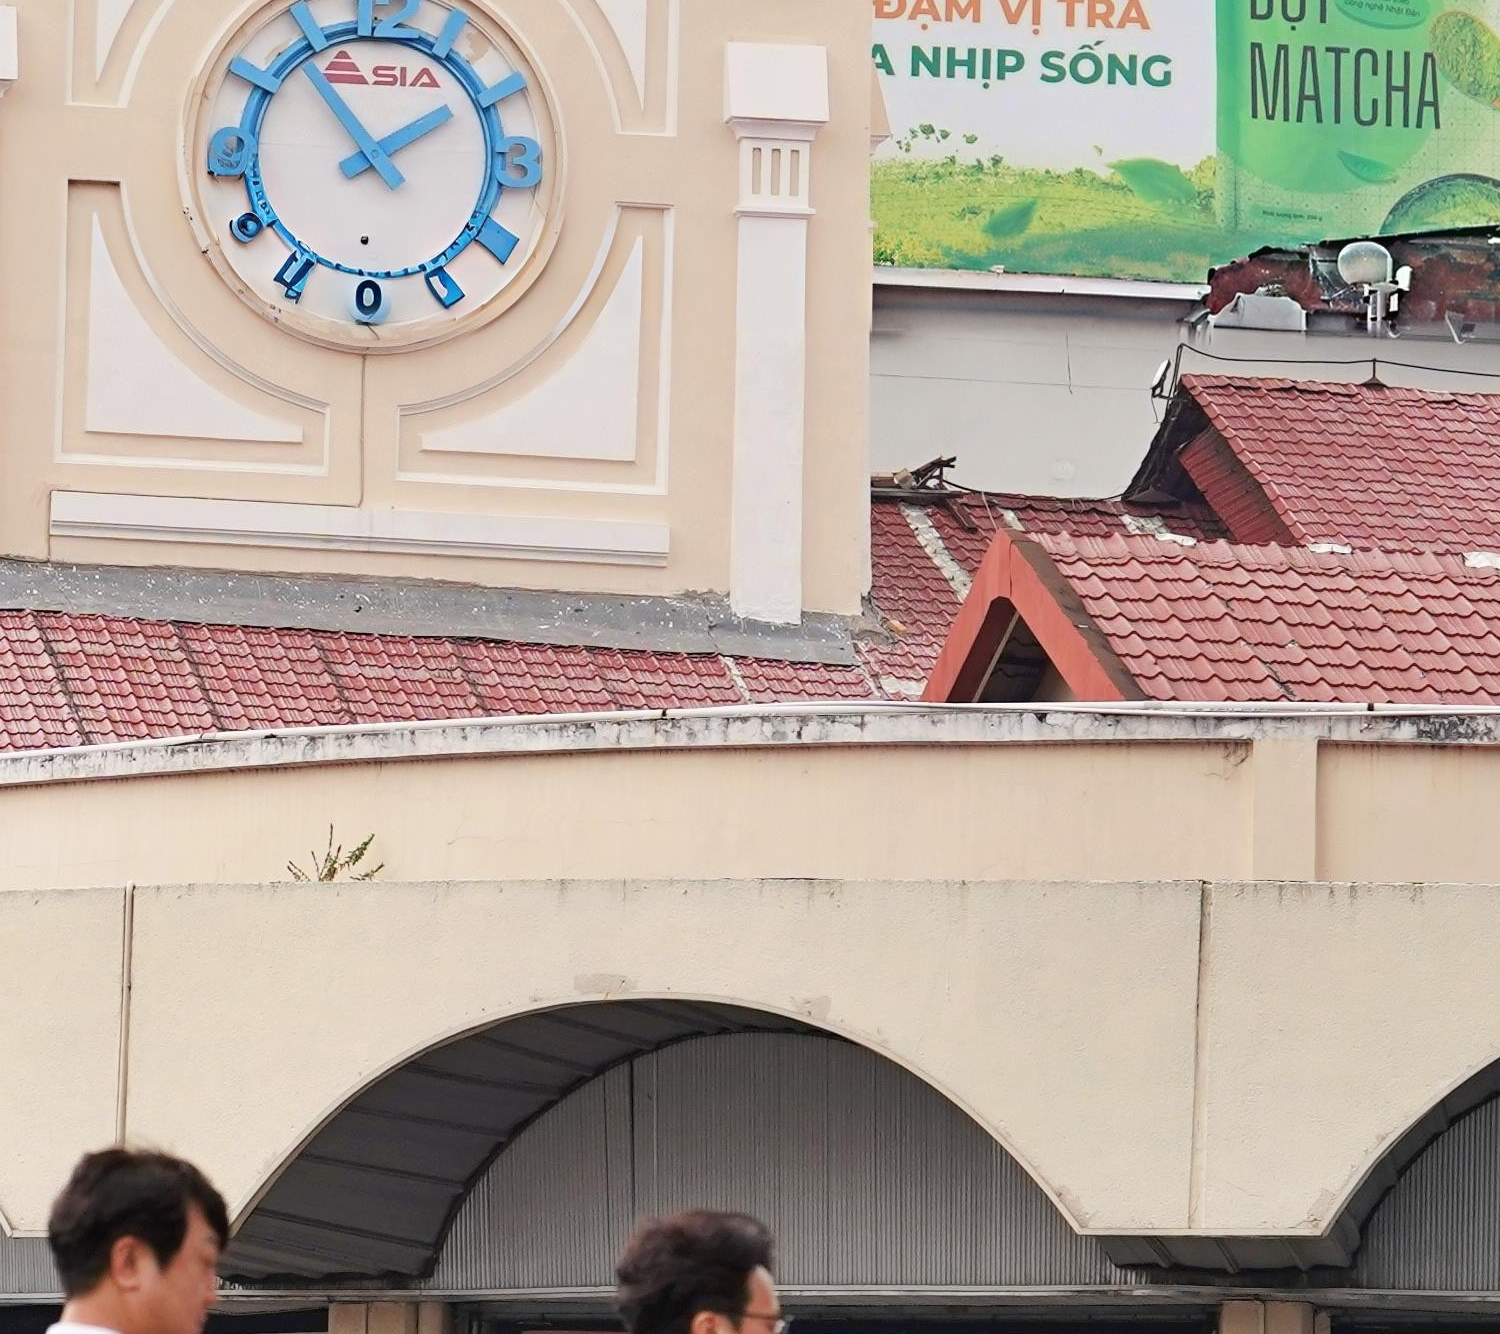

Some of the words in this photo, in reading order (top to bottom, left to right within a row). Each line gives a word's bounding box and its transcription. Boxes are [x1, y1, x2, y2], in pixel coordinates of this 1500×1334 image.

[910, 44, 1026, 90] NHỊP
[1040, 39, 1173, 88] SỐNG
[1249, 41, 1442, 131] MATCHA
